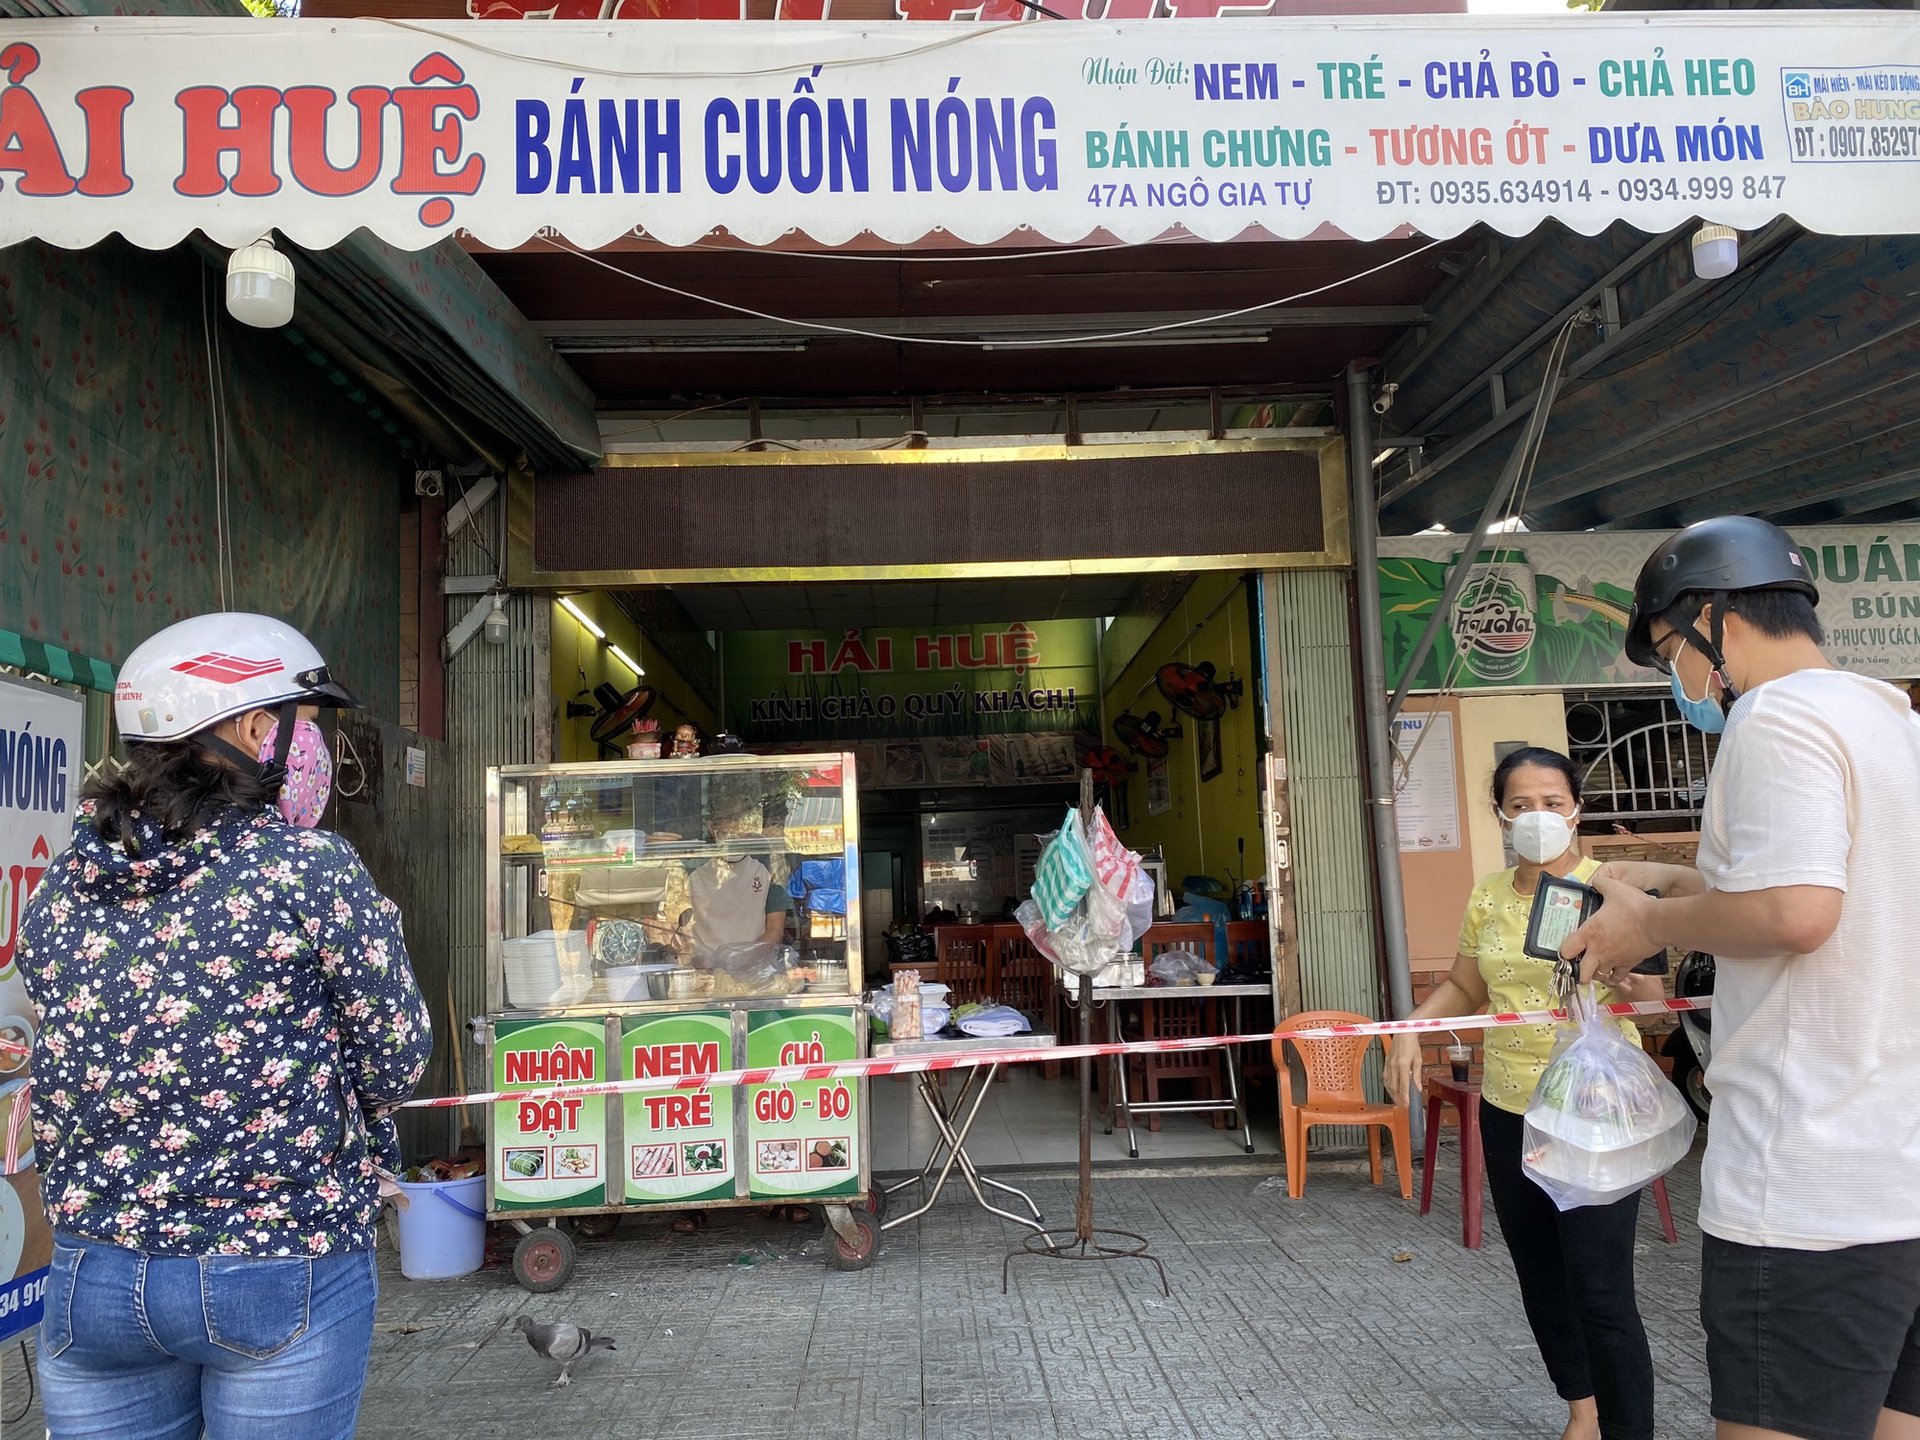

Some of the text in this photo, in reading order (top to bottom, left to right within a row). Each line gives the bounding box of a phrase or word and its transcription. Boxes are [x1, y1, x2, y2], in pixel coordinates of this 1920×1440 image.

[1081, 56, 1138, 90] Nhận
[1144, 56, 1190, 90] Đặt:
[1194, 63, 1279, 100] NEM
[1317, 54, 1386, 100] TRÉ
[1424, 49, 1500, 99] CHẢ
[1510, 51, 1560, 98] BÒ
[1599, 46, 1674, 97] CHẢ
[1684, 57, 1757, 96] HEO
[515, 65, 1059, 194] BÁNH CUỐN NÓNG
[1792, 96, 1850, 121] BẢO
[174, 51, 486, 228] HUỆ
[1085, 122, 1190, 168] BÁNH
[1203, 125, 1332, 168] CHƯNG
[1369, 124, 1494, 166] TƯƠNG
[1505, 119, 1550, 165] ỚT
[1588, 122, 1665, 164] DƯA
[1675, 117, 1764, 162] MÓN
[1087, 176, 1313, 210] 47A NGÔ GIA TỰ
[1376, 181, 1420, 205] ĐT:
[1430, 179, 1592, 204] 0935.634914
[1618, 176, 1734, 201] 0934.999
[1743, 175, 1787, 199] 847
[787, 622, 1041, 676] HẢI HUỆ
[1833, 628, 1867, 651] PHỤC
[1868, 628, 1886, 651] VỤ
[1889, 624, 1912, 646] CÁC
[751, 691, 812, 722] KÍNH
[820, 688, 896, 719] CHÀO
[903, 683, 965, 721] QUÝ
[504, 1041, 595, 1089] NHẬN
[780, 1032, 826, 1066] CHẢ
[634, 1042, 720, 1130] NEM TRÉ
[754, 1080, 796, 1122] GIÒ
[818, 1079, 852, 1120] BÒ
